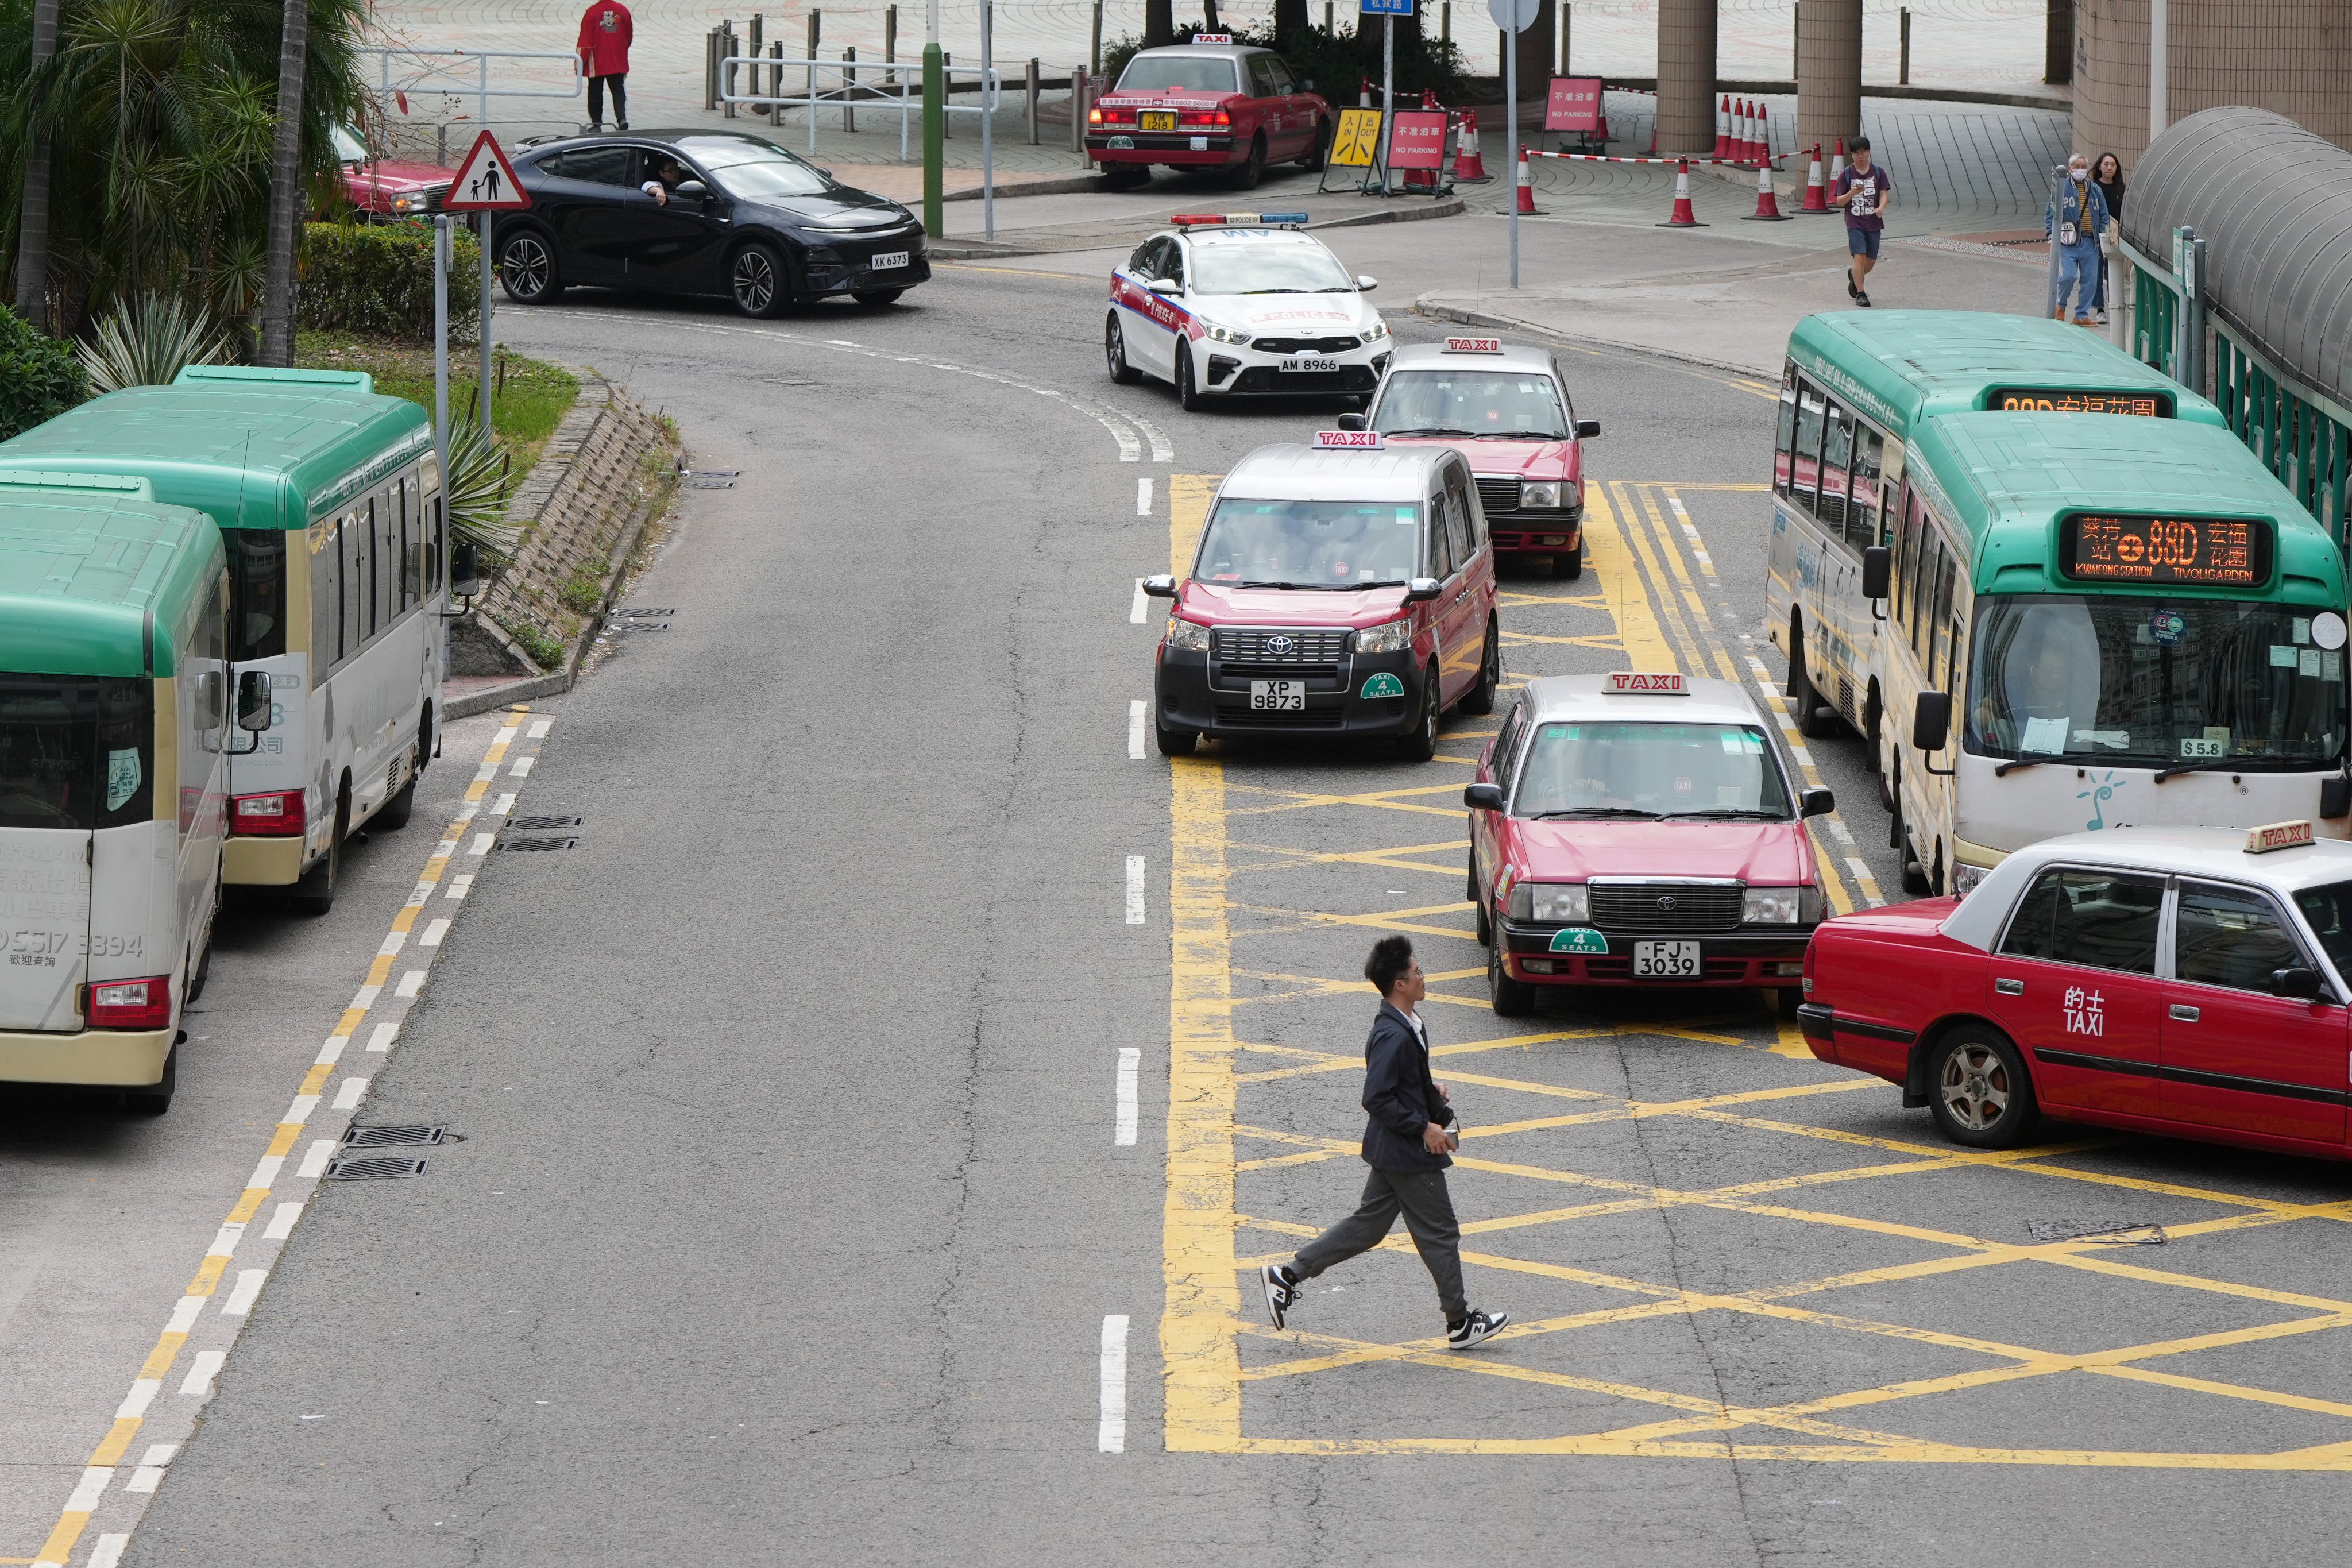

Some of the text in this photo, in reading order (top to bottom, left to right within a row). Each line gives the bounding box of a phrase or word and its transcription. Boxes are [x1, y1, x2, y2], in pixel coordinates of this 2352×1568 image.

[1555, 92, 1594, 101] 不准泊車
[1148, 121, 1168, 130] 1218
[1346, 117, 1353, 126] 入
[1366, 117, 1374, 126] 出
[1398, 126, 1440, 136] 不准泊車
[875, 254, 906, 267] XK 6373
[1449, 339, 1497, 350] TAXI
[1282, 360, 1337, 370] AM 8966
[1319, 432, 1376, 445] TAXI
[2208, 522, 2247, 544] 宏福
[2148, 520, 2197, 565] 88D
[2092, 539, 2111, 561] 站
[2210, 546, 2247, 567] 花園
[1378, 681, 1387, 690] 4
[1613, 675, 1680, 689] TAXI
[1267, 682, 1289, 696] XP
[1254, 696, 1301, 709] 9873
[1675, 782, 1691, 790] TAXI
[2262, 824, 2311, 846] TAXI
[1574, 933, 1585, 945] 4
[1654, 942, 1681, 958] FJ
[10, 955, 56, 967] 歡迎查詢
[1639, 958, 1694, 975] 3039
[2064, 986, 2104, 1013] 的士
[2063, 1009, 2103, 1037] TAXI
